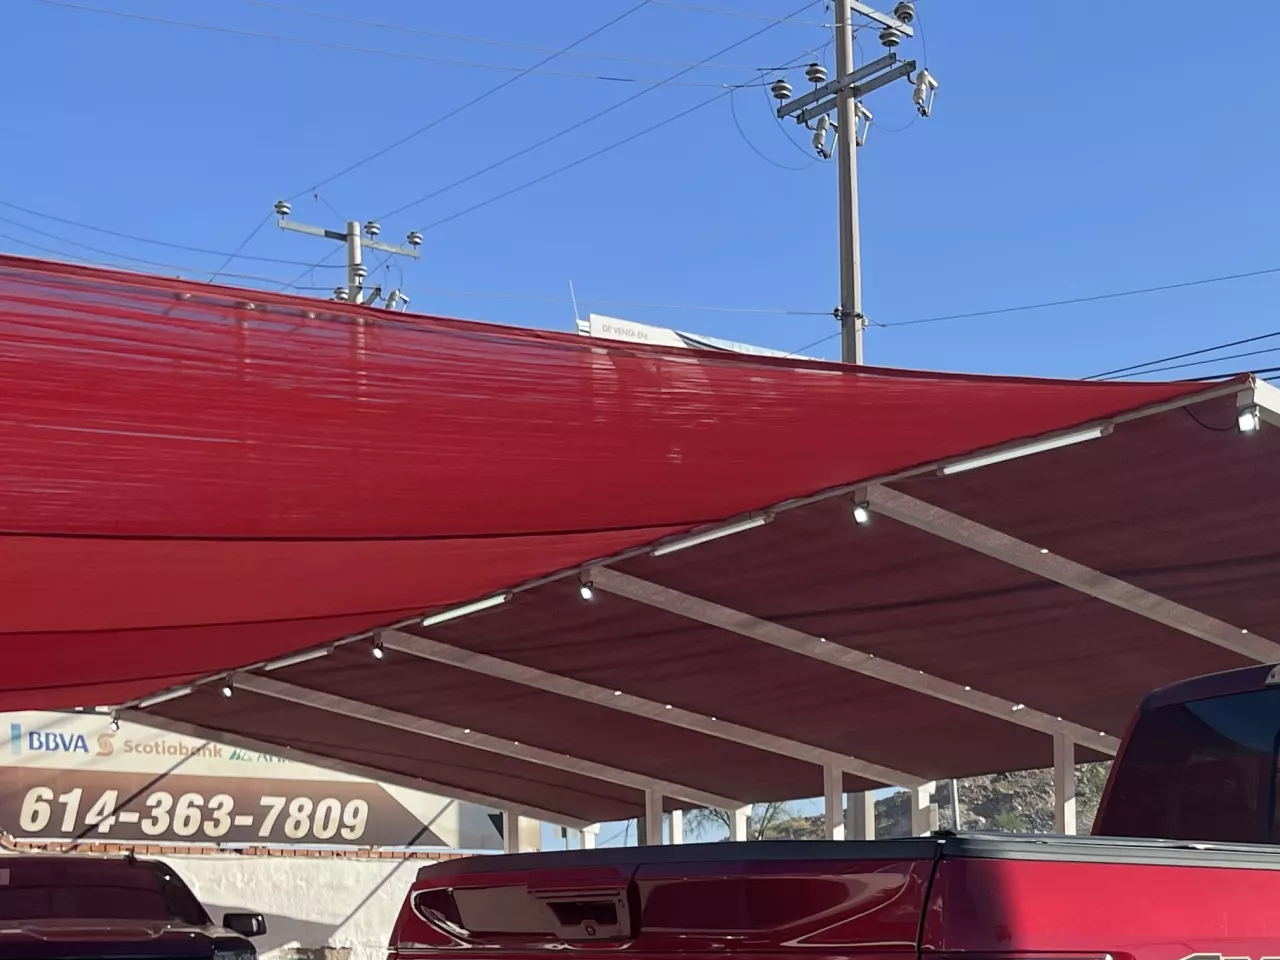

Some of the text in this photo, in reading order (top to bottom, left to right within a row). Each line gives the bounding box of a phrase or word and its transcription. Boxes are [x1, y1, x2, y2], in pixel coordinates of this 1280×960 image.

[602, 324, 612, 334] DE
[613, 327, 636, 338] VENTA
[28, 731, 90, 753] BBVA
[123, 739, 223, 758] Scotiabank
[19, 786, 369, 840] 614-363-7809
